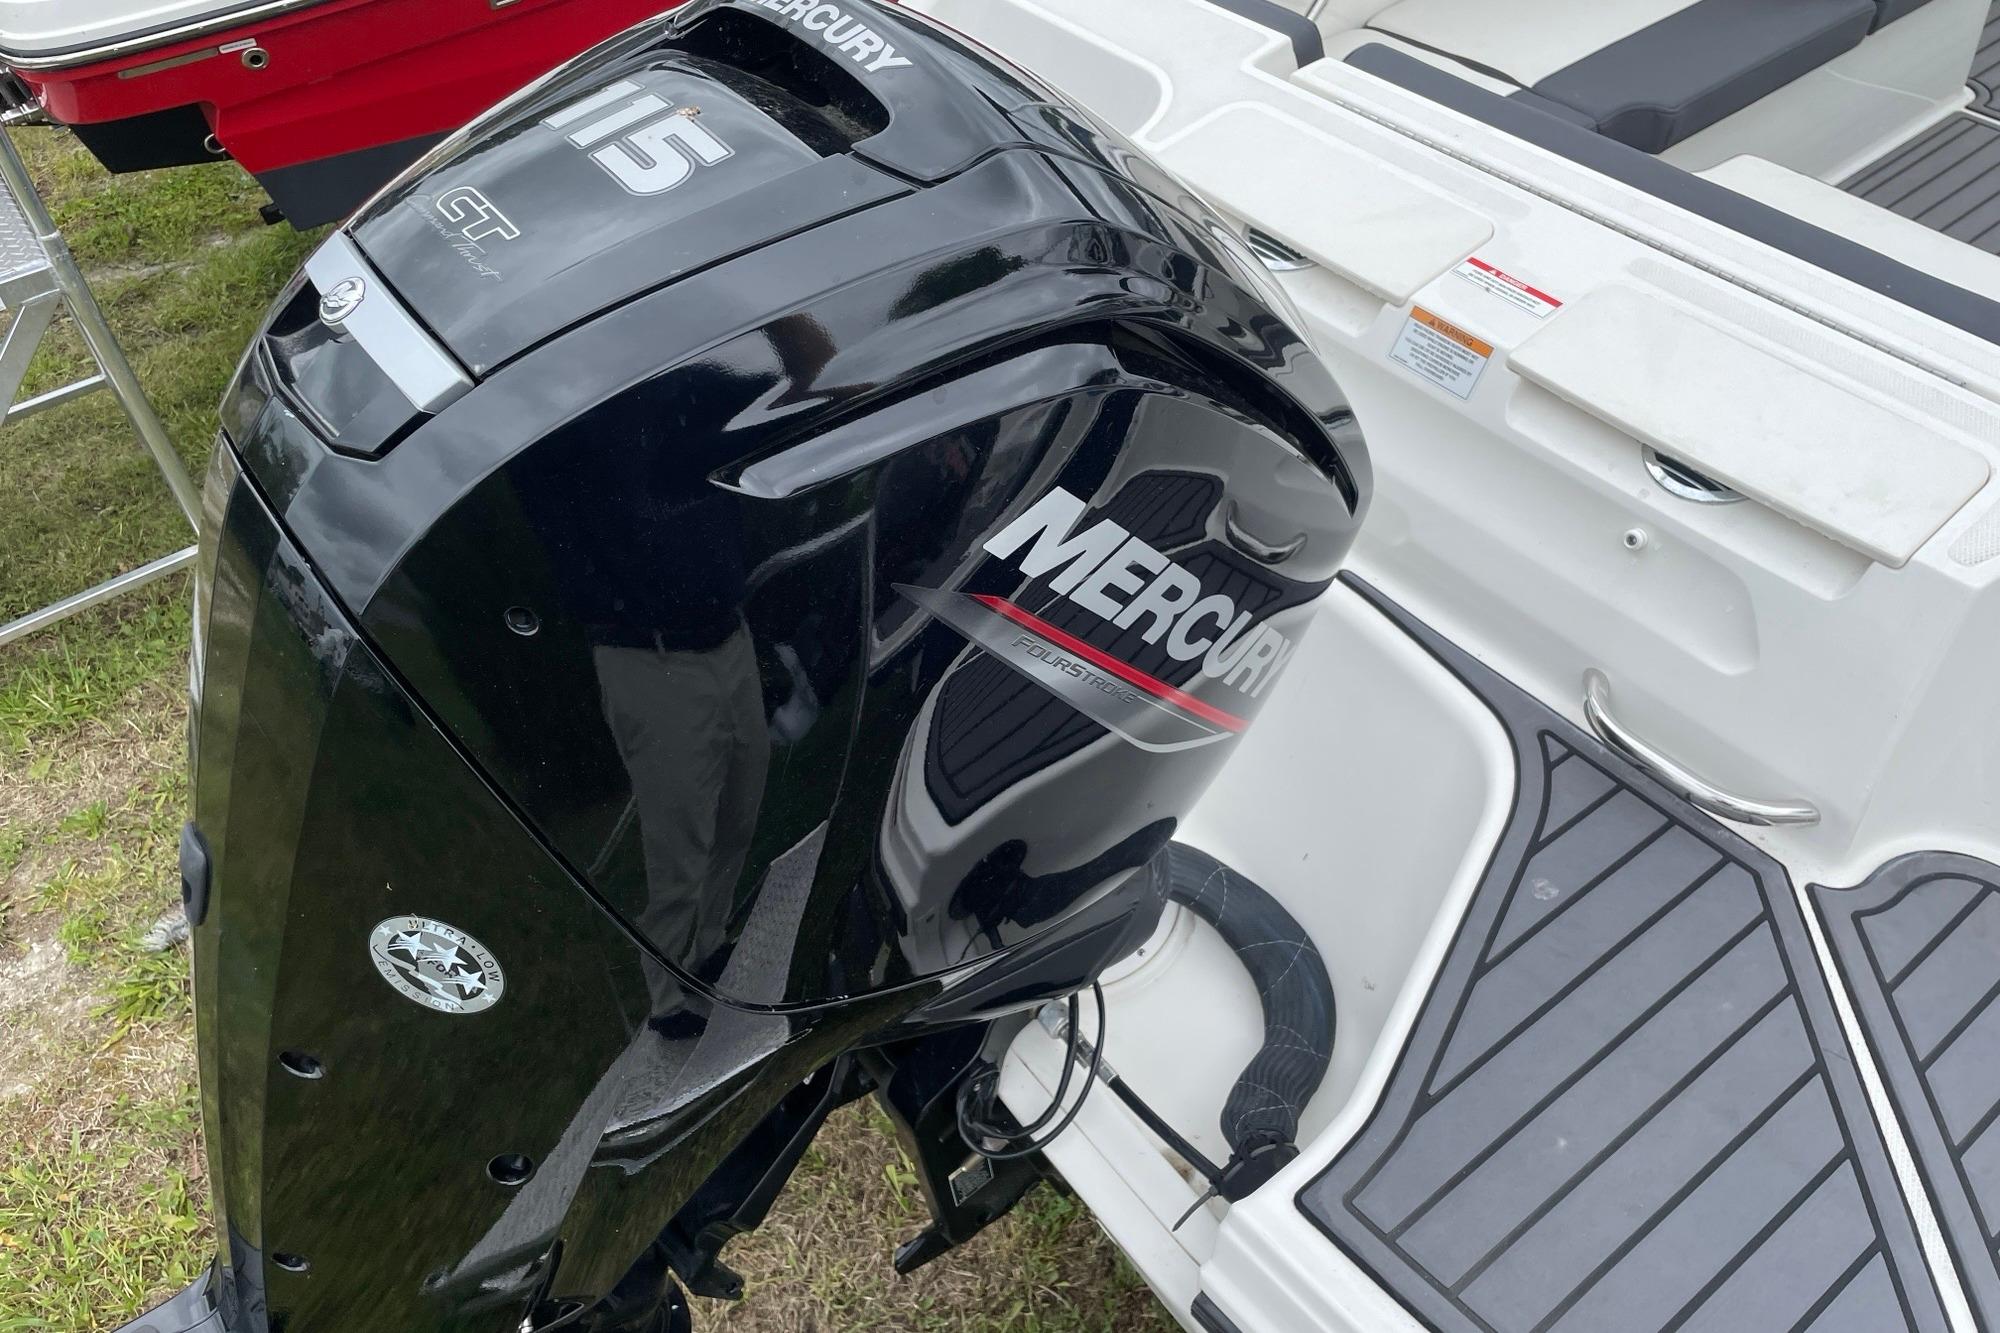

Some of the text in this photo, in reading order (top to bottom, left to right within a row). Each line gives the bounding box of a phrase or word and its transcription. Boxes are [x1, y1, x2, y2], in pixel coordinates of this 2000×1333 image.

[755, 0, 913, 73] ERCURY
[541, 79, 735, 195] 115
[436, 186, 520, 241] GT
[452, 233, 503, 281] Thrust
[1436, 320, 1474, 347] WARNING
[983, 486, 1297, 698] MERCURY
[408, 919, 500, 982] ULTRA LOW
[378, 960, 455, 1011] EMISSION
